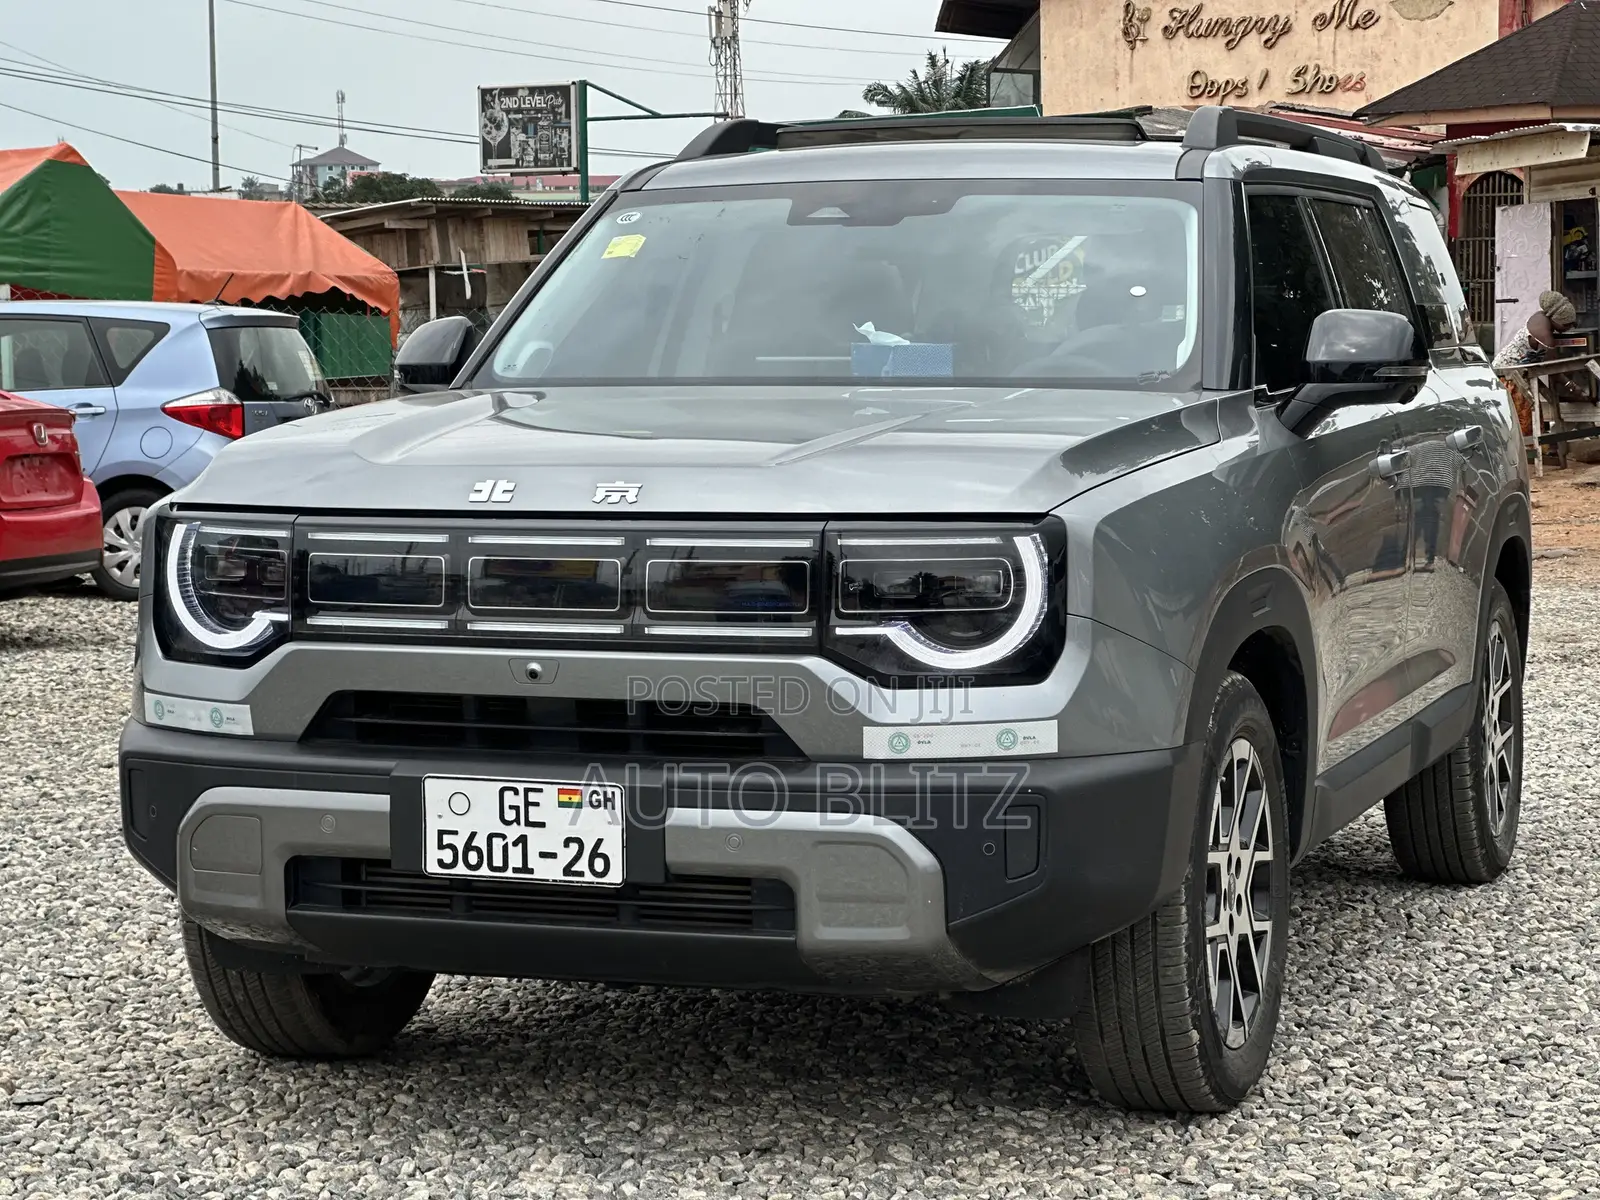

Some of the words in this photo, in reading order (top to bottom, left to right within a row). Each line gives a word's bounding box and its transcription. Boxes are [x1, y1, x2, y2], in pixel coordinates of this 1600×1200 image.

[1161, 2, 1293, 50] Hungry
[1311, 0, 1381, 31] Me
[500, 97, 519, 109] 2ND
[520, 95, 546, 108] LEVEL
[1186, 69, 1249, 106] Oops
[1285, 63, 1367, 95] Shoes
[468, 479, 643, 504] 北京
[498, 786, 546, 828] GE
[588, 789, 616, 811] GH
[437, 829, 611, 879] 5601-26
